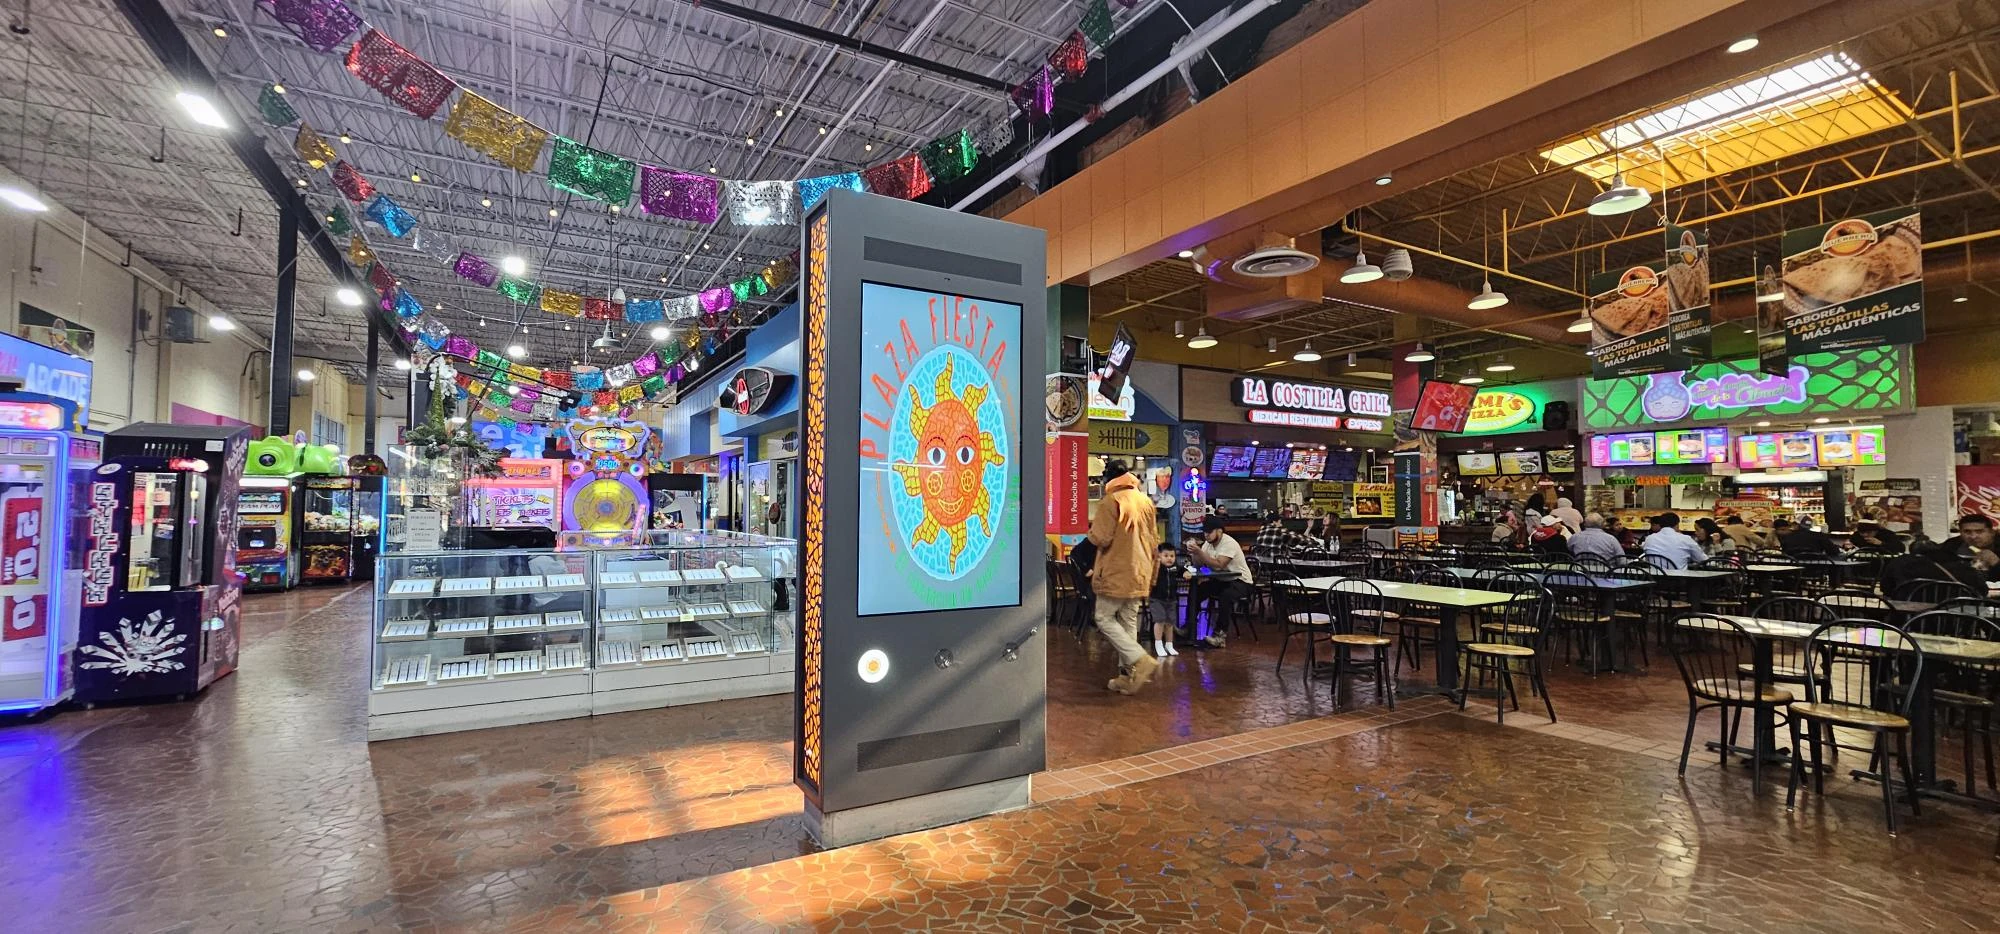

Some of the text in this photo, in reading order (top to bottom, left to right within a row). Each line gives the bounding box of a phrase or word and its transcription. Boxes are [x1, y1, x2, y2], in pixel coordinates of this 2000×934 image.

[1670, 313, 1690, 323] SABOREA
[1787, 305, 1846, 328] SABOREA
[1792, 302, 1889, 335] LAS TORTILLAS
[1802, 302, 1921, 341] MÁS AUTÉNTICAS
[1593, 339, 1636, 357] SABOREA
[1598, 353, 1615, 363] LAS
[1617, 337, 1667, 356] TORTILLAS
[1605, 355, 1626, 368] MÁS
[25, 361, 89, 404] ARCADE
[860, 319, 920, 460] PLAZA
[928, 296, 1007, 380] FIESTA
[1243, 379, 1391, 416] LA COSTILLA GRILL
[1253, 410, 1336, 428] MEXICAN RESTAURANT
[1349, 418, 1382, 431] EXPRESS
[1071, 470, 1078, 481] de
[1070, 481, 1078, 515] Pedacito
[1071, 514, 1078, 525] Un
